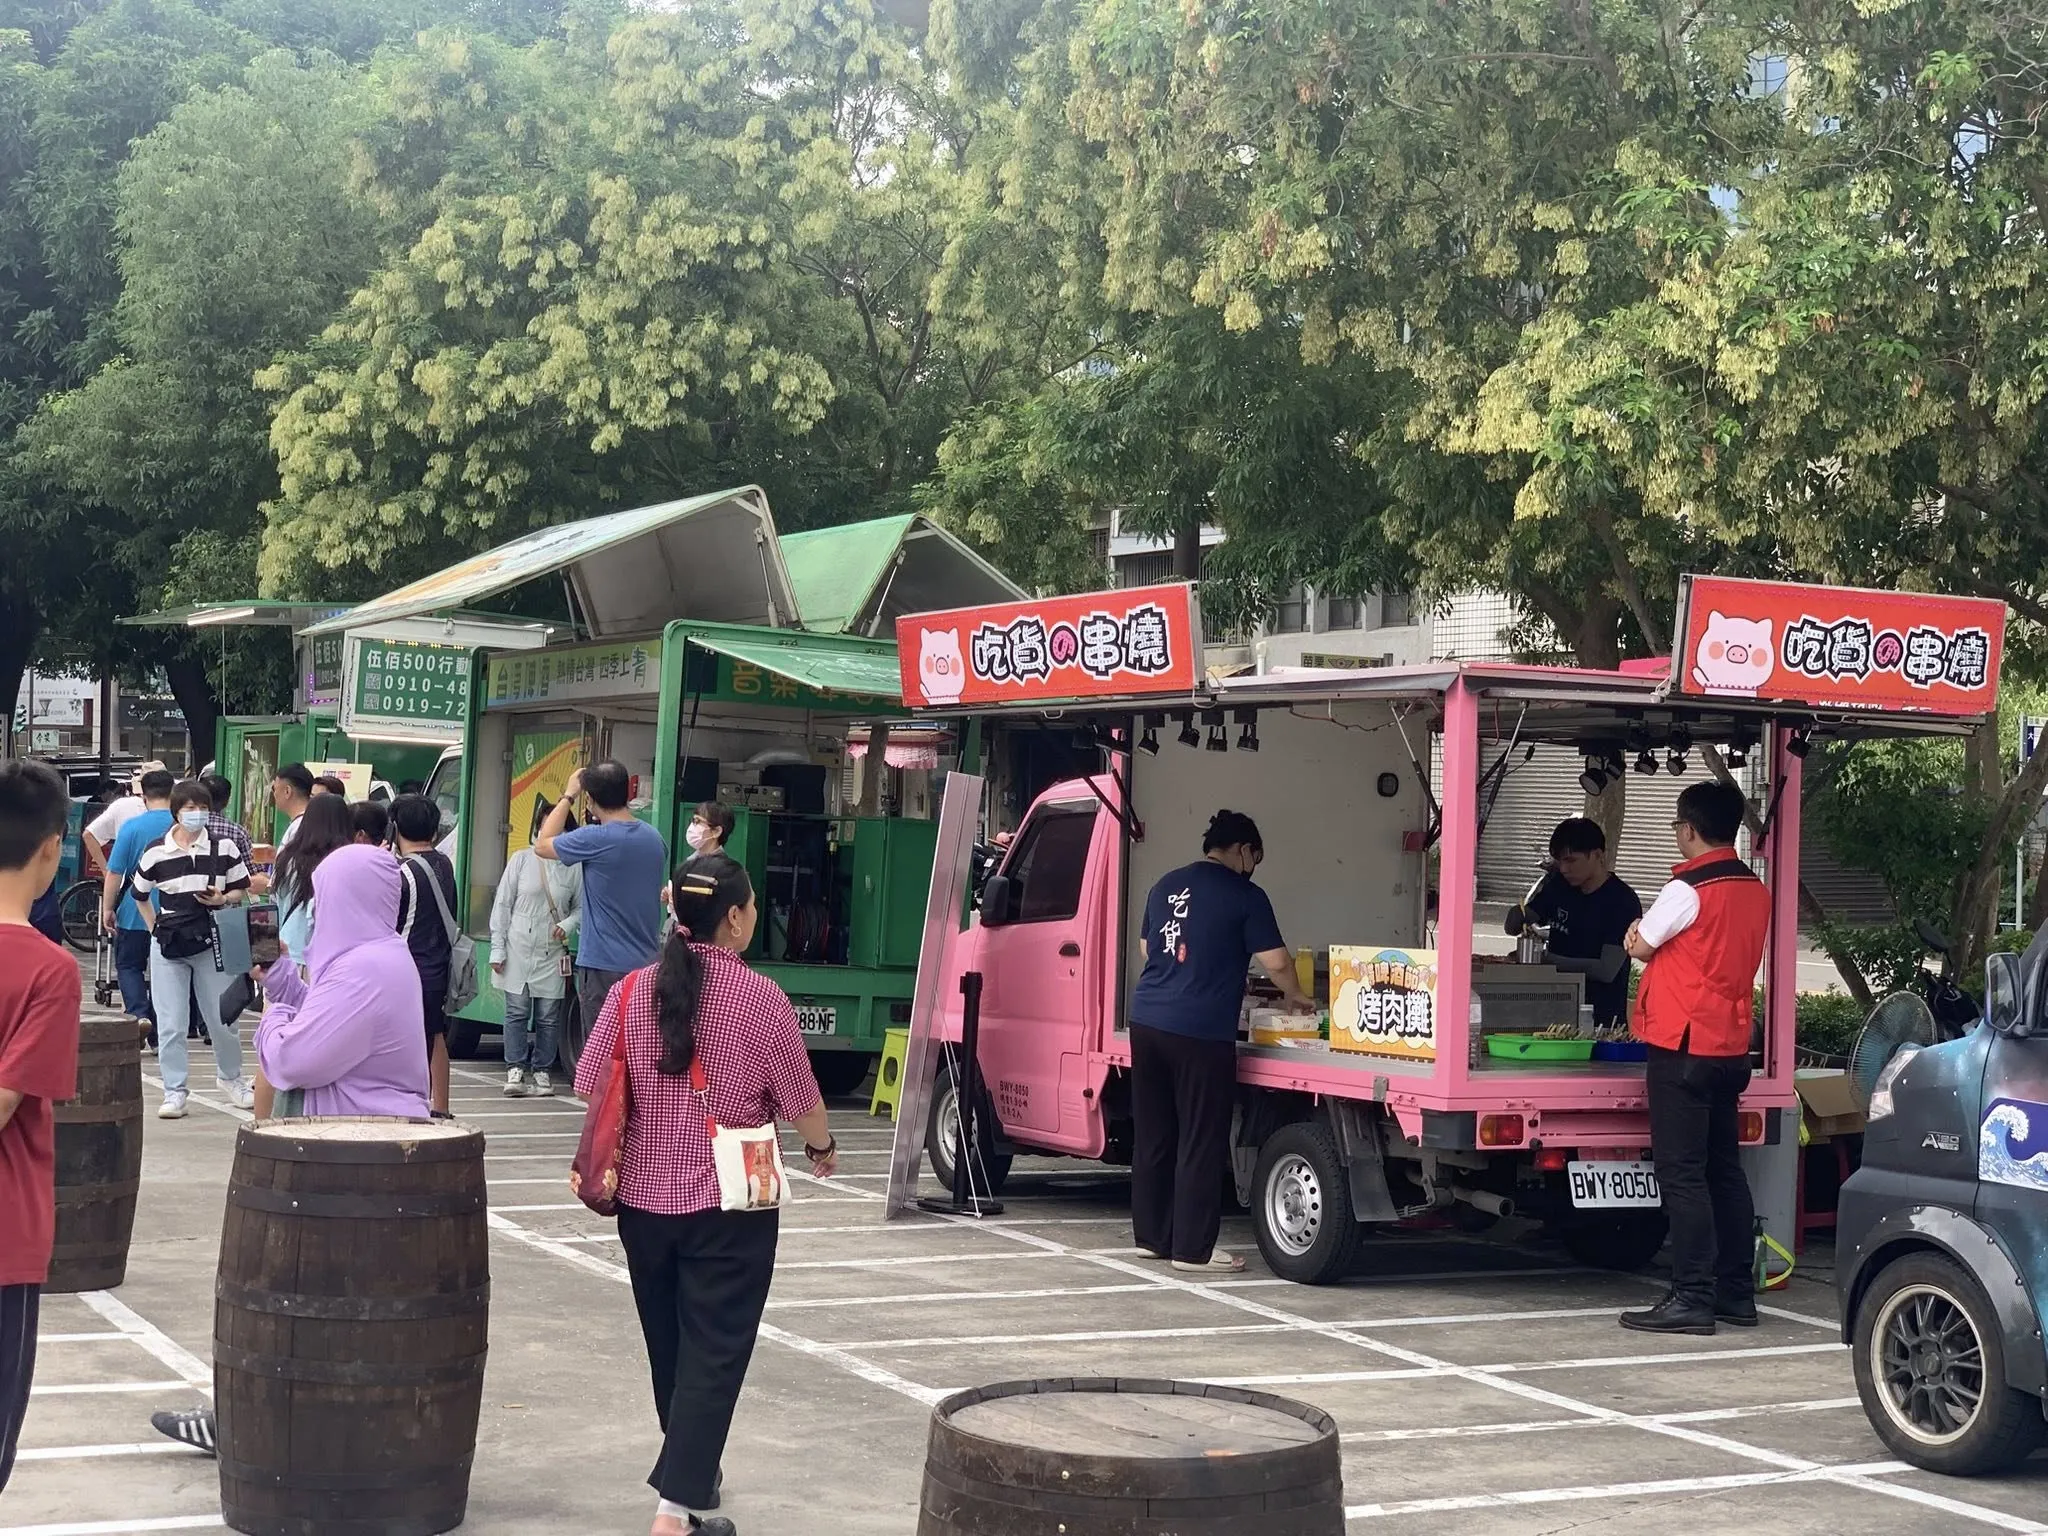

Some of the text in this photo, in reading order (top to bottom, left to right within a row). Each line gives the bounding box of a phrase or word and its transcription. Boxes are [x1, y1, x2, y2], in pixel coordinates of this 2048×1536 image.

[971, 604, 1172, 686] 吃貨の串燒
[1782, 614, 1990, 690] 吃貨の串燒
[1159, 887, 1191, 956] 吃貨
[1357, 987, 1433, 1038] 烤肉攤
